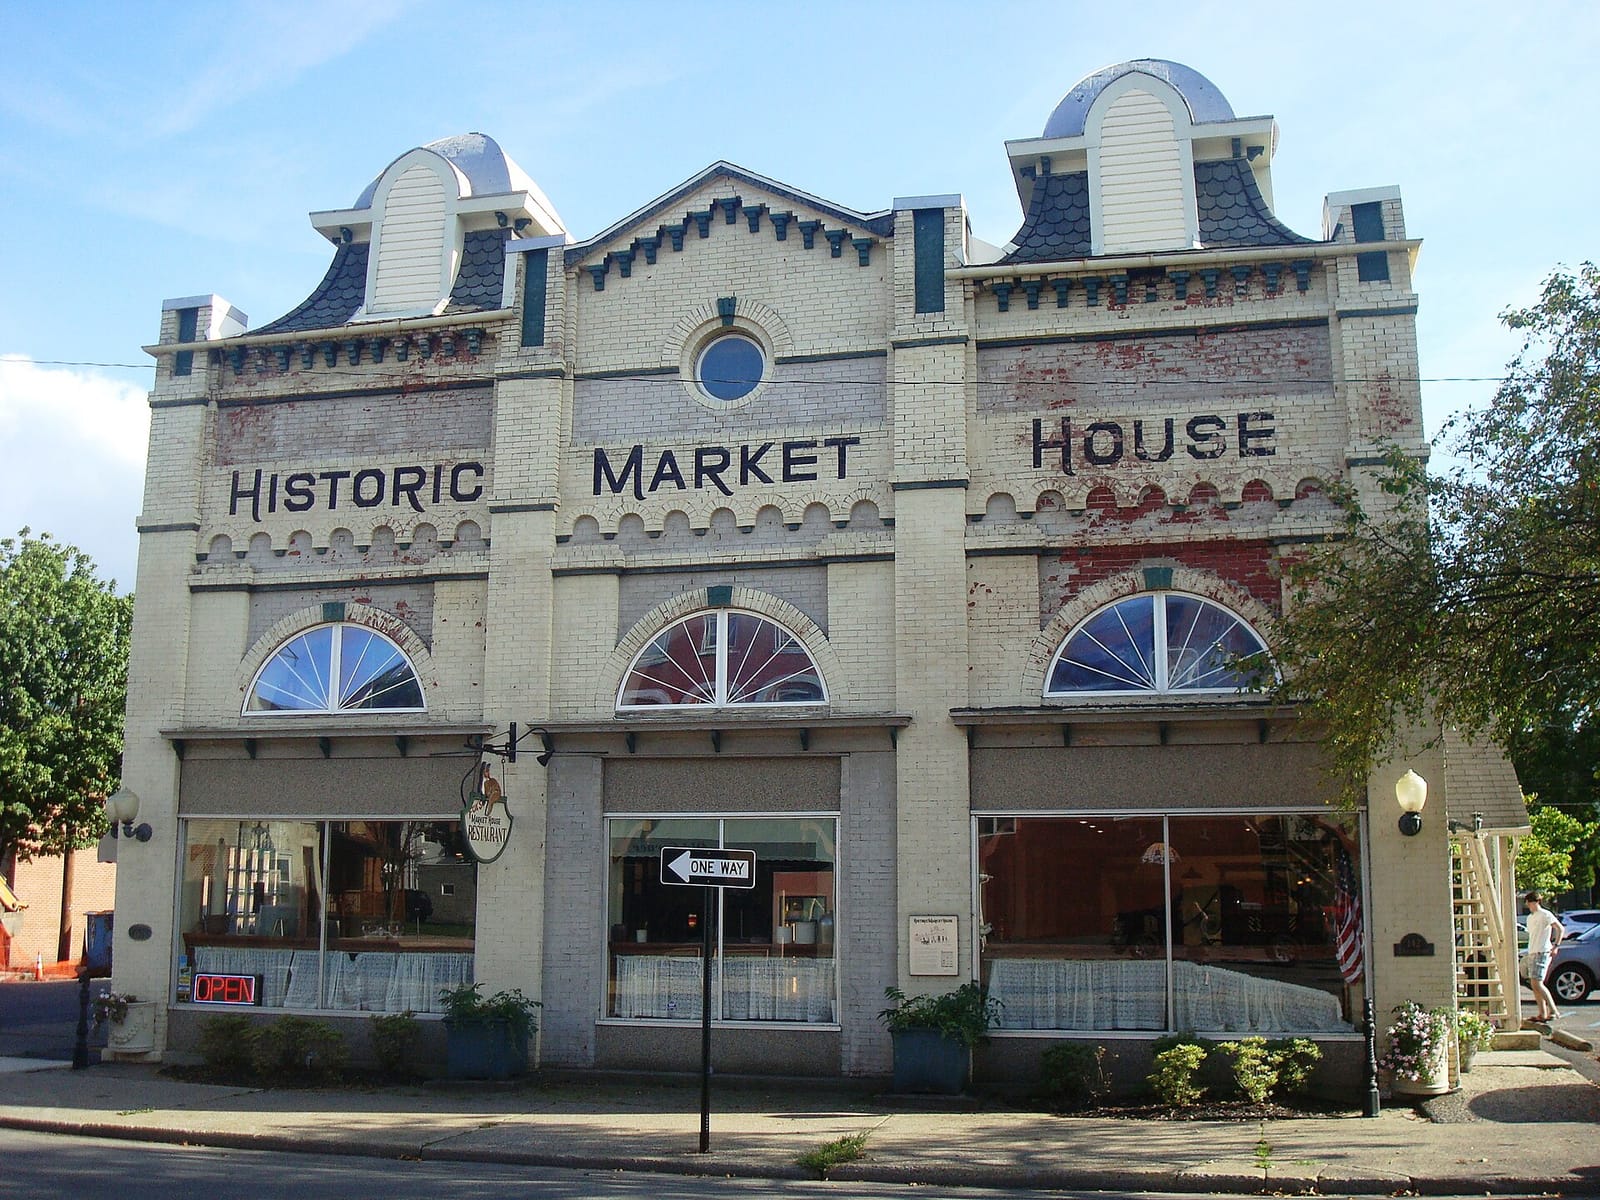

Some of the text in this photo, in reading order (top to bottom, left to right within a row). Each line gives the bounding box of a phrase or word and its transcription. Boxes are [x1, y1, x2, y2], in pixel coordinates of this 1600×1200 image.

[229, 411, 1276, 522] HISTORIC MARKET HOUSE
[468, 825, 507, 842] RESTAURANT
[690, 860, 745, 875] ONE WAY
[196, 976, 253, 1002] OPEN
